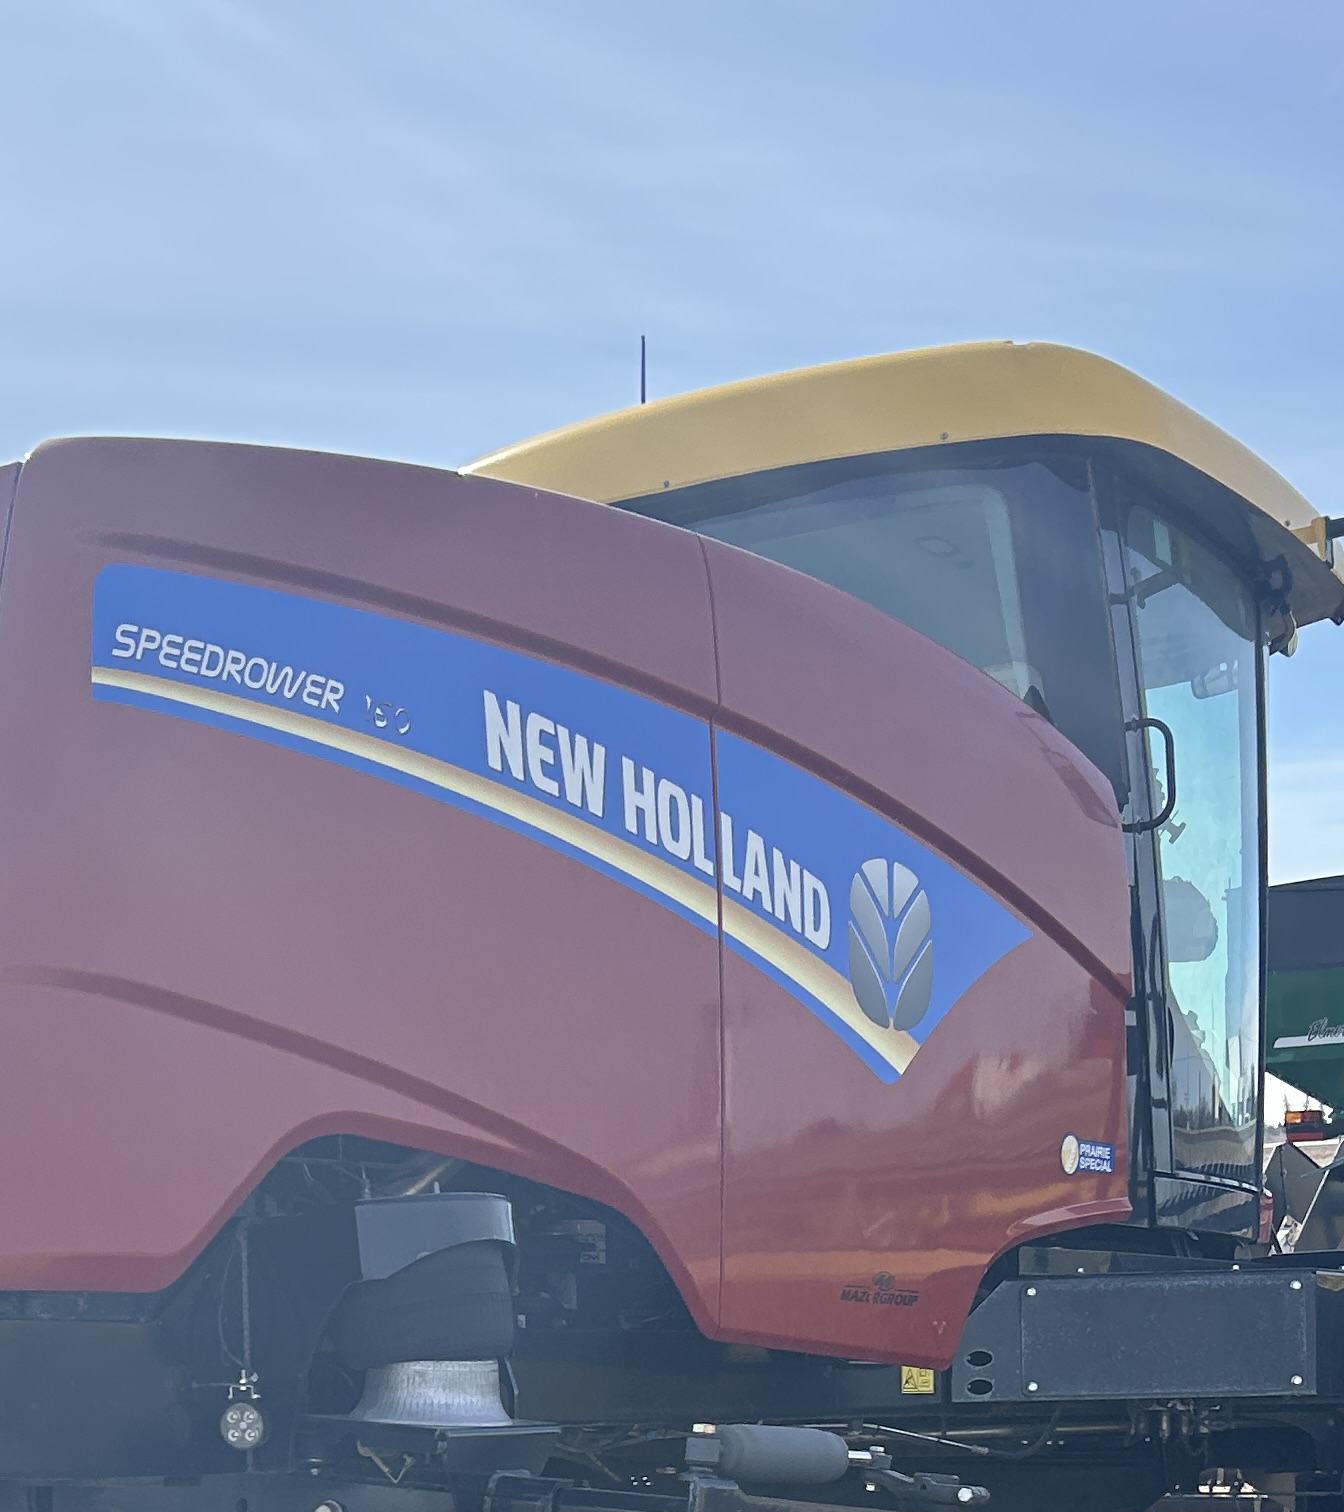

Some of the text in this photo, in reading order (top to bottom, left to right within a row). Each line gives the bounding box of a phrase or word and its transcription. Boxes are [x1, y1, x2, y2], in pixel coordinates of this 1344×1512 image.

[112, 623, 345, 713] SPEEDROWER
[483, 689, 831, 950] NEW HOLLAND
[1079, 1143, 1111, 1160] PRAIRIE
[1079, 1156, 1112, 1173] SPECIAL
